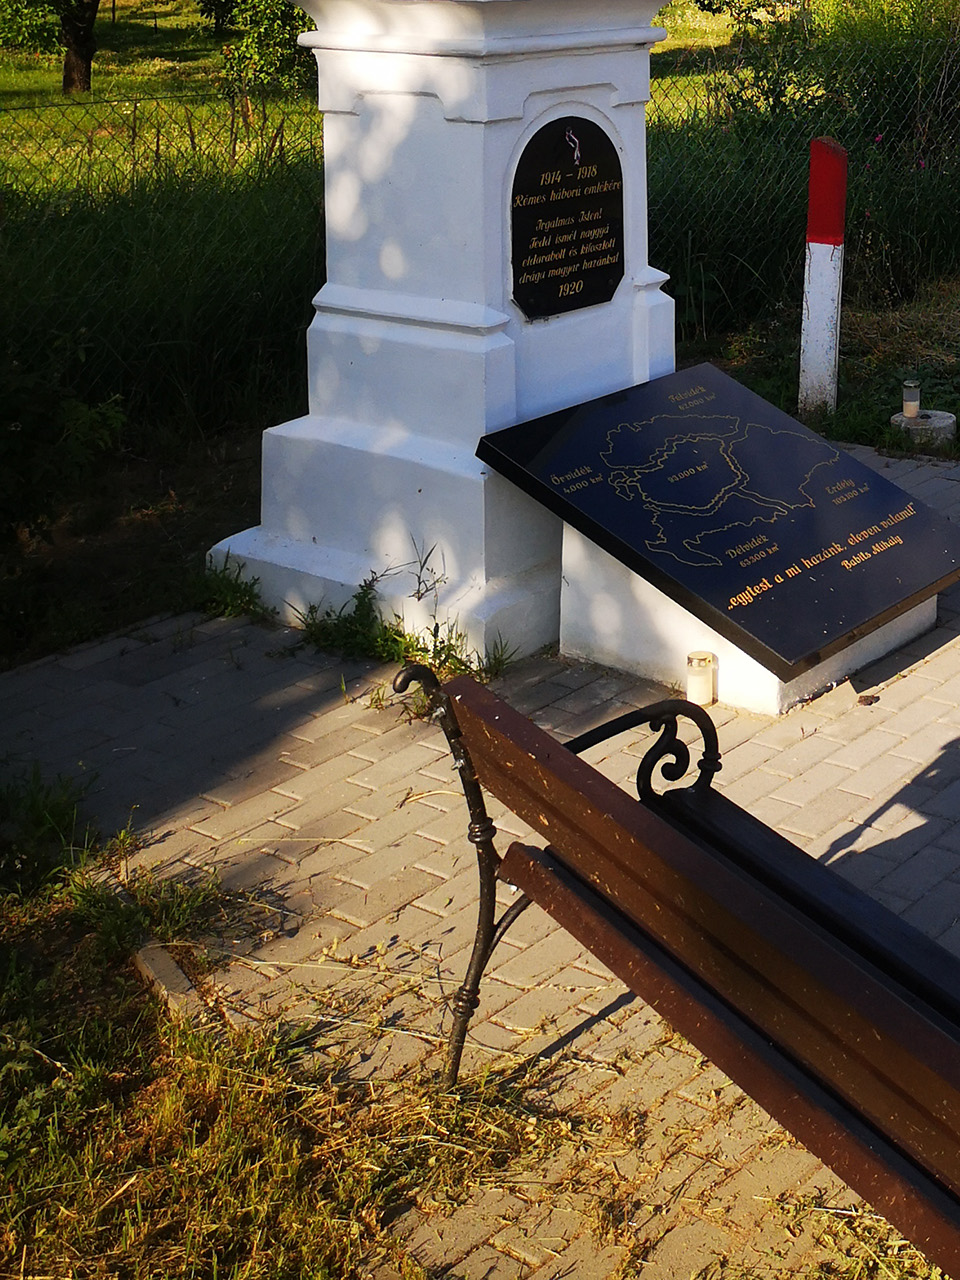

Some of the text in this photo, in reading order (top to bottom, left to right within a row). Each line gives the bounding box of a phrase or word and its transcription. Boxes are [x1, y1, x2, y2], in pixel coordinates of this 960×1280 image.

[540, 170, 562, 186] 1914
[577, 164, 599, 180] 1918
[550, 186, 581, 201] háború
[583, 179, 621, 195] emlékére
[535, 207, 602, 233] Irgalmas Isten!
[529, 223, 609, 249] Tedd ismét naggyá
[568, 246, 578, 257] és
[518, 252, 620, 284] drága magyar hazánkat
[558, 279, 584, 297] 1920
[668, 385, 706, 403] Felvidék
[824, 478, 856, 495] Erdély
[725, 533, 769, 560] Délvidék
[774, 574, 785, 585] a
[784, 562, 802, 579] mi
[800, 542, 847, 570] hazánk,
[847, 531, 882, 547] eleven
[840, 534, 904, 571] Babits Mihály
